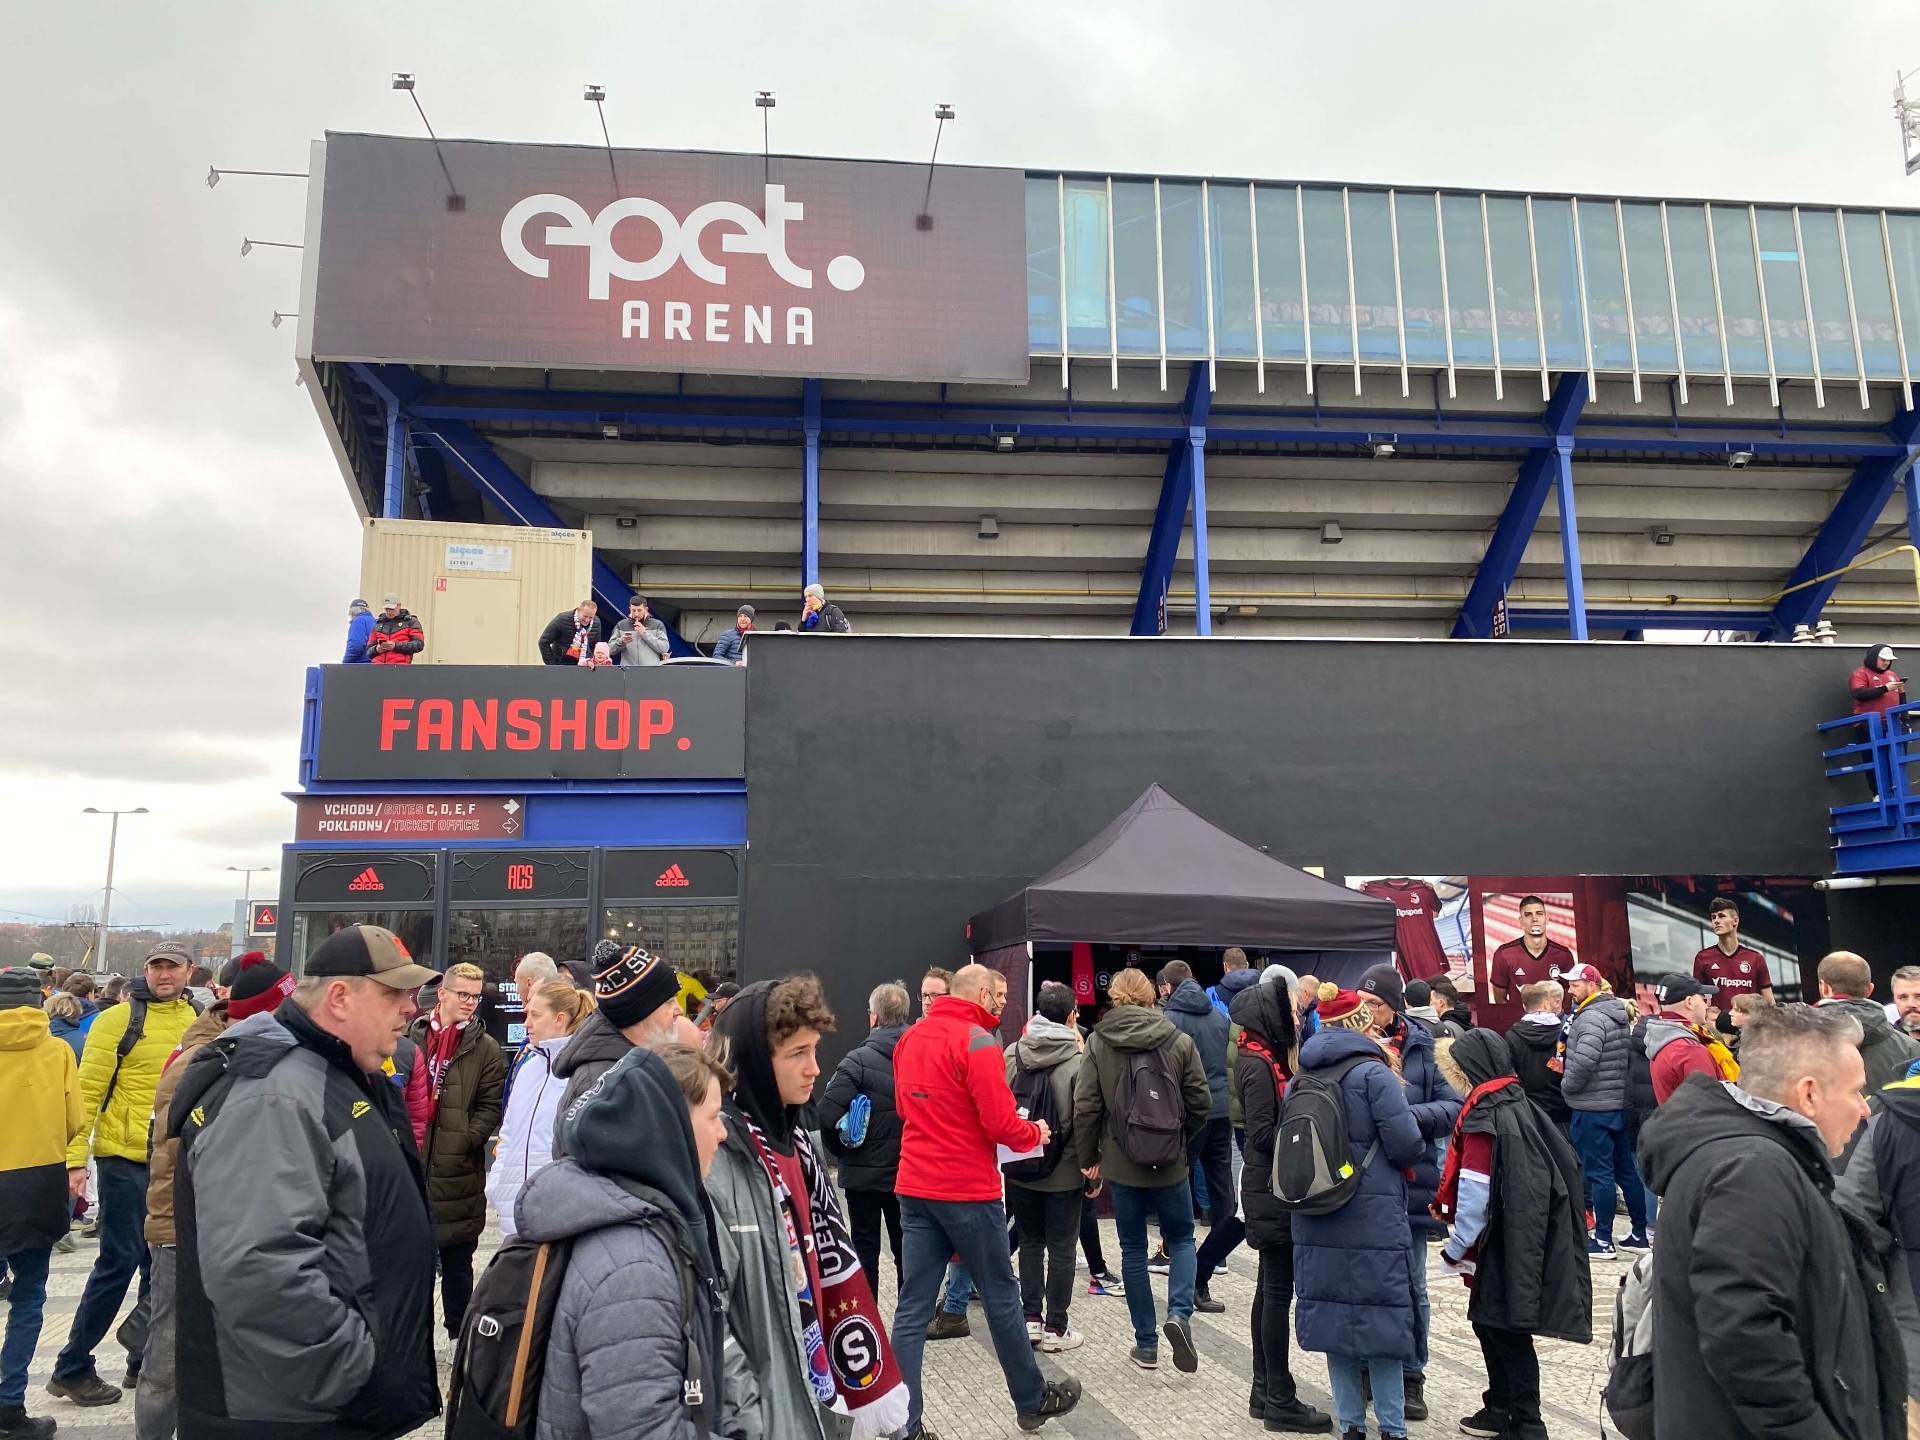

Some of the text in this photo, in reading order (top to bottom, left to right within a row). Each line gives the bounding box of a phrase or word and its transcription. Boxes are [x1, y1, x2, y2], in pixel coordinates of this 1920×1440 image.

[622, 301, 813, 345] ARENA
[380, 699, 691, 750] FANSHOP.
[468, 804, 476, 815] F
[437, 819, 480, 831] OFFICE
[508, 865, 534, 890] ACS
[655, 877, 690, 887] adidas
[349, 881, 384, 891] adidas
[1720, 977, 1753, 988] Tipsport
[842, 1329, 870, 1372] S
